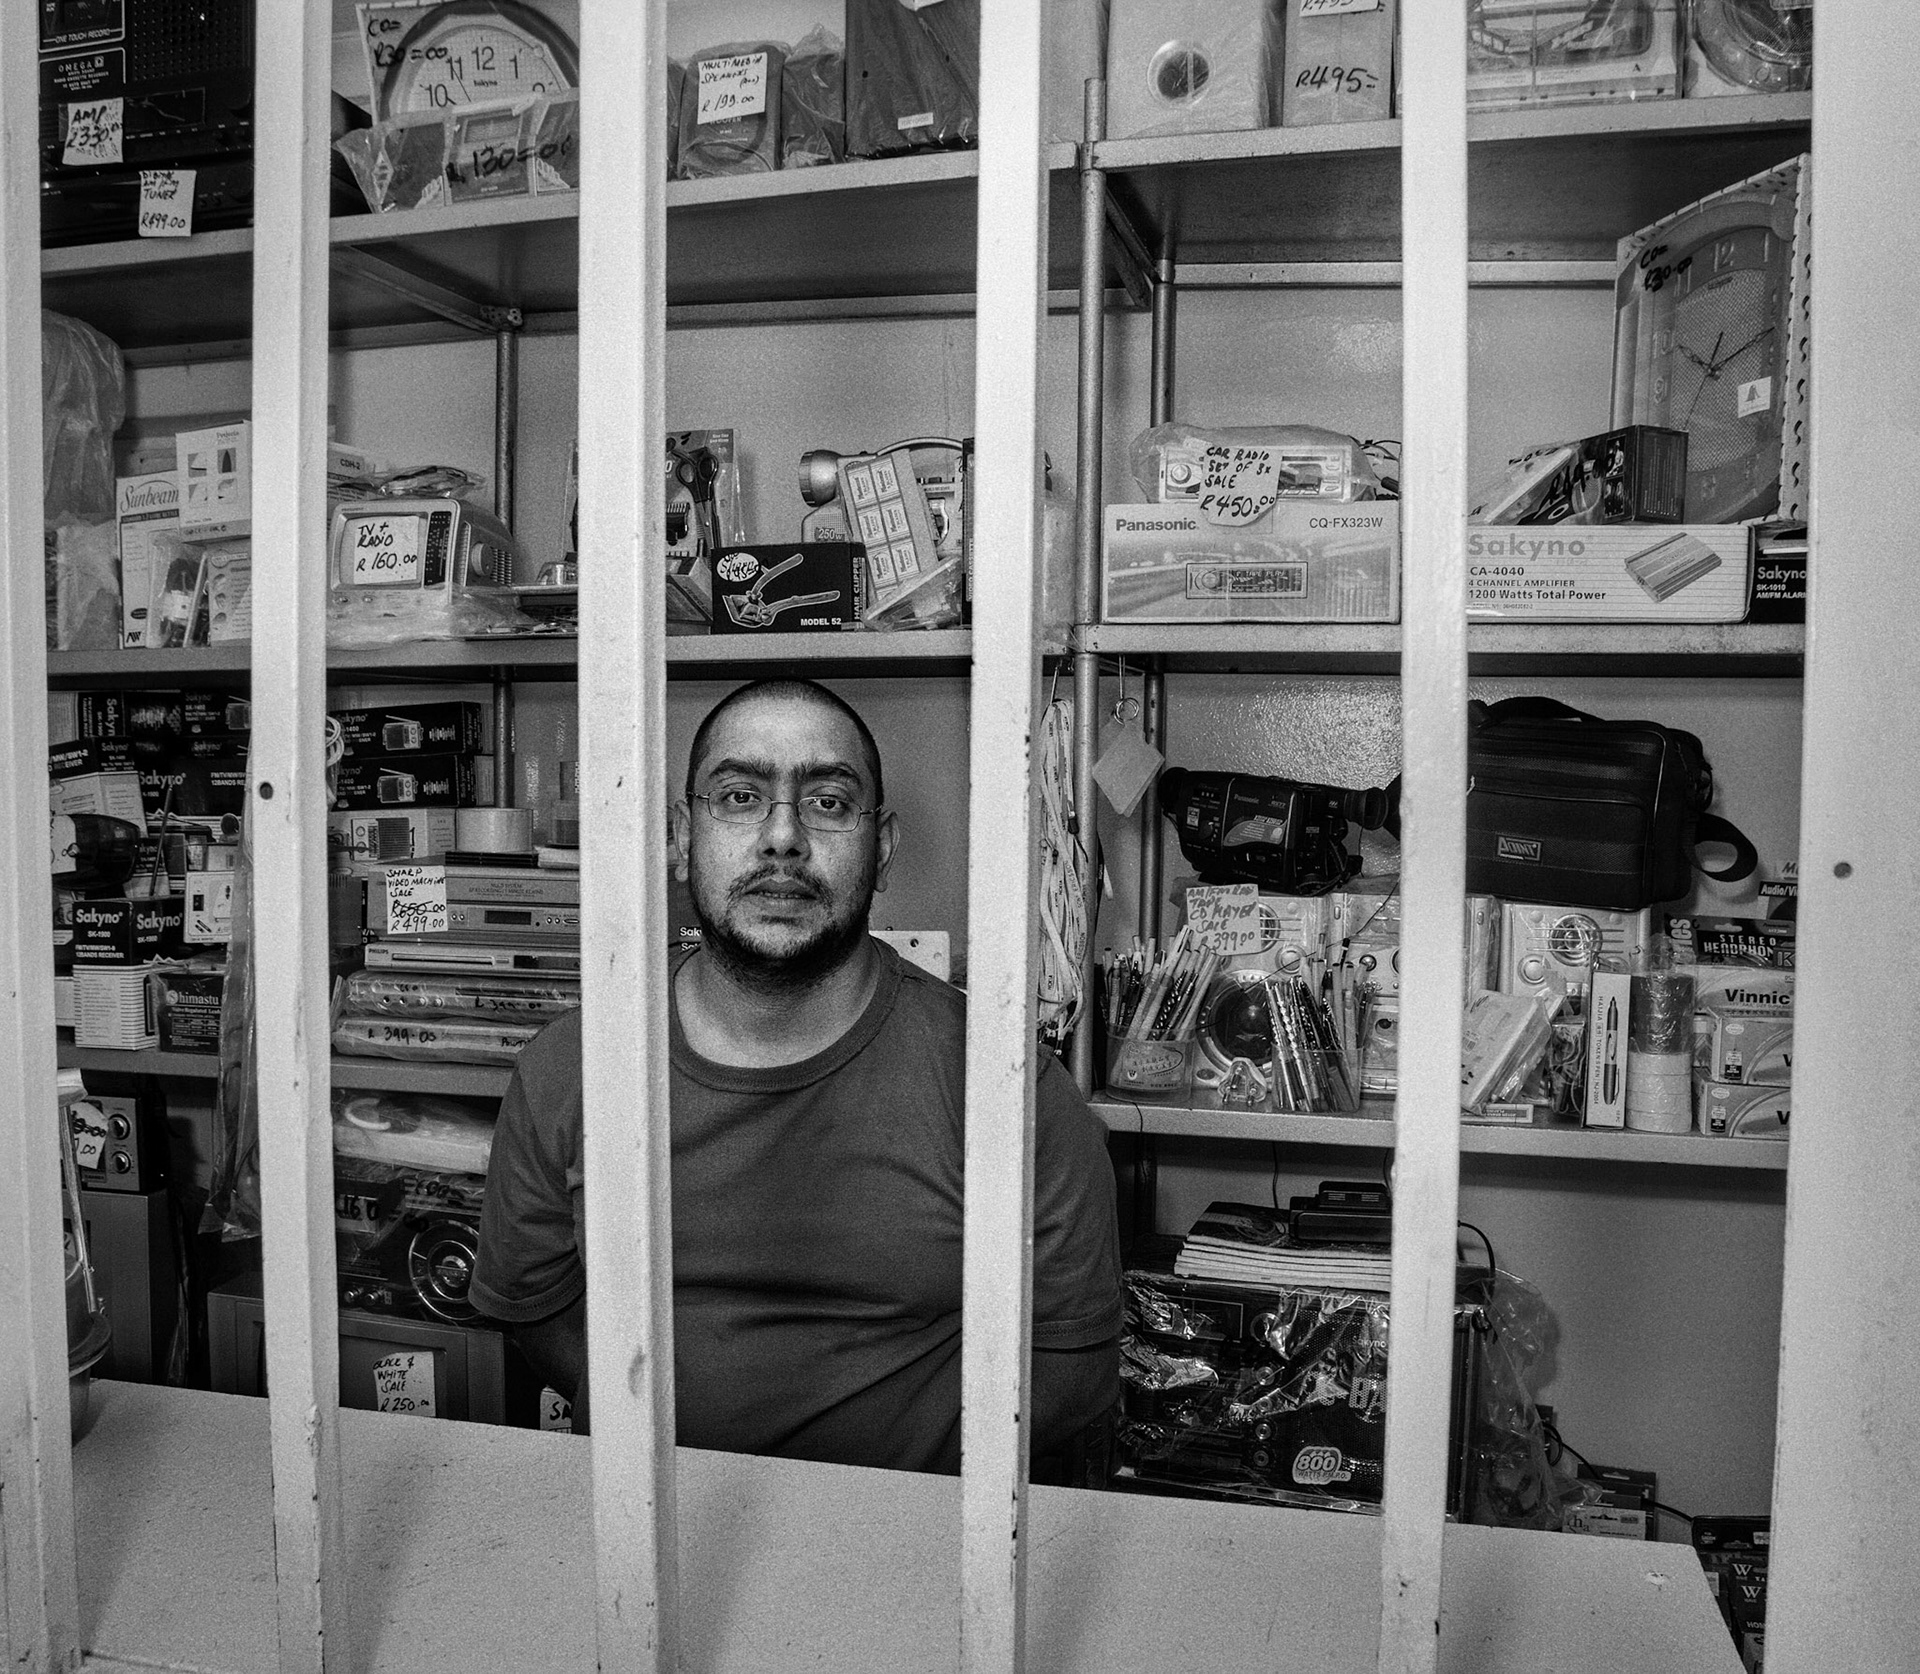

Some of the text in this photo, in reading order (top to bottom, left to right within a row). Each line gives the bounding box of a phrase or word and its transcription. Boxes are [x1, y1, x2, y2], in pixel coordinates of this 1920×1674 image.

[471, 46, 495, 71] 12
[446, 56, 463, 80] 11
[510, 54, 518, 79] 1
[424, 84, 448, 107] 10
[143, 188, 177, 200] TUNER
[1206, 447, 1269, 461] CAR RADIO
[1208, 459, 1229, 473] SET
[1235, 461, 1253, 473] OF
[1204, 474, 1237, 489] SALE
[120, 485, 179, 513] Sunbeam
[358, 523, 375, 535] TV
[1116, 517, 1384, 532] Panasonic CQ-FX323W
[1468, 532, 1586, 562] Sakyno
[853, 557, 861, 594] CLIPPER
[1470, 566, 1525, 576] CA-4040
[1757, 564, 1807, 583] Sakyno
[1468, 579, 1576, 588] 4 CHANNEL AMPLIFIER
[1756, 583, 1787, 591] SK-1010
[1468, 589, 1607, 600] 1200 Watts Total Power
[1781, 591, 1807, 599] ALAR
[800, 617, 842, 626] MODEL 52
[105, 698, 119, 737] Sakyn
[387, 867, 422, 877] SHARP
[388, 878, 410, 888] VIDEO
[390, 887, 414, 897] SALE
[1760, 884, 1797, 897] Audio/Vi
[76, 907, 121, 927] Sakyno
[1190, 907, 1207, 920] CD
[136, 910, 181, 933] Sakyno
[1196, 919, 1229, 934] SALE
[1719, 934, 1777, 946] STEREO
[166, 990, 219, 1005] Shimastu
[1725, 988, 1791, 1005] Vinnic
[381, 1380, 406, 1393] SALE
[1297, 1454, 1337, 1472] 800
